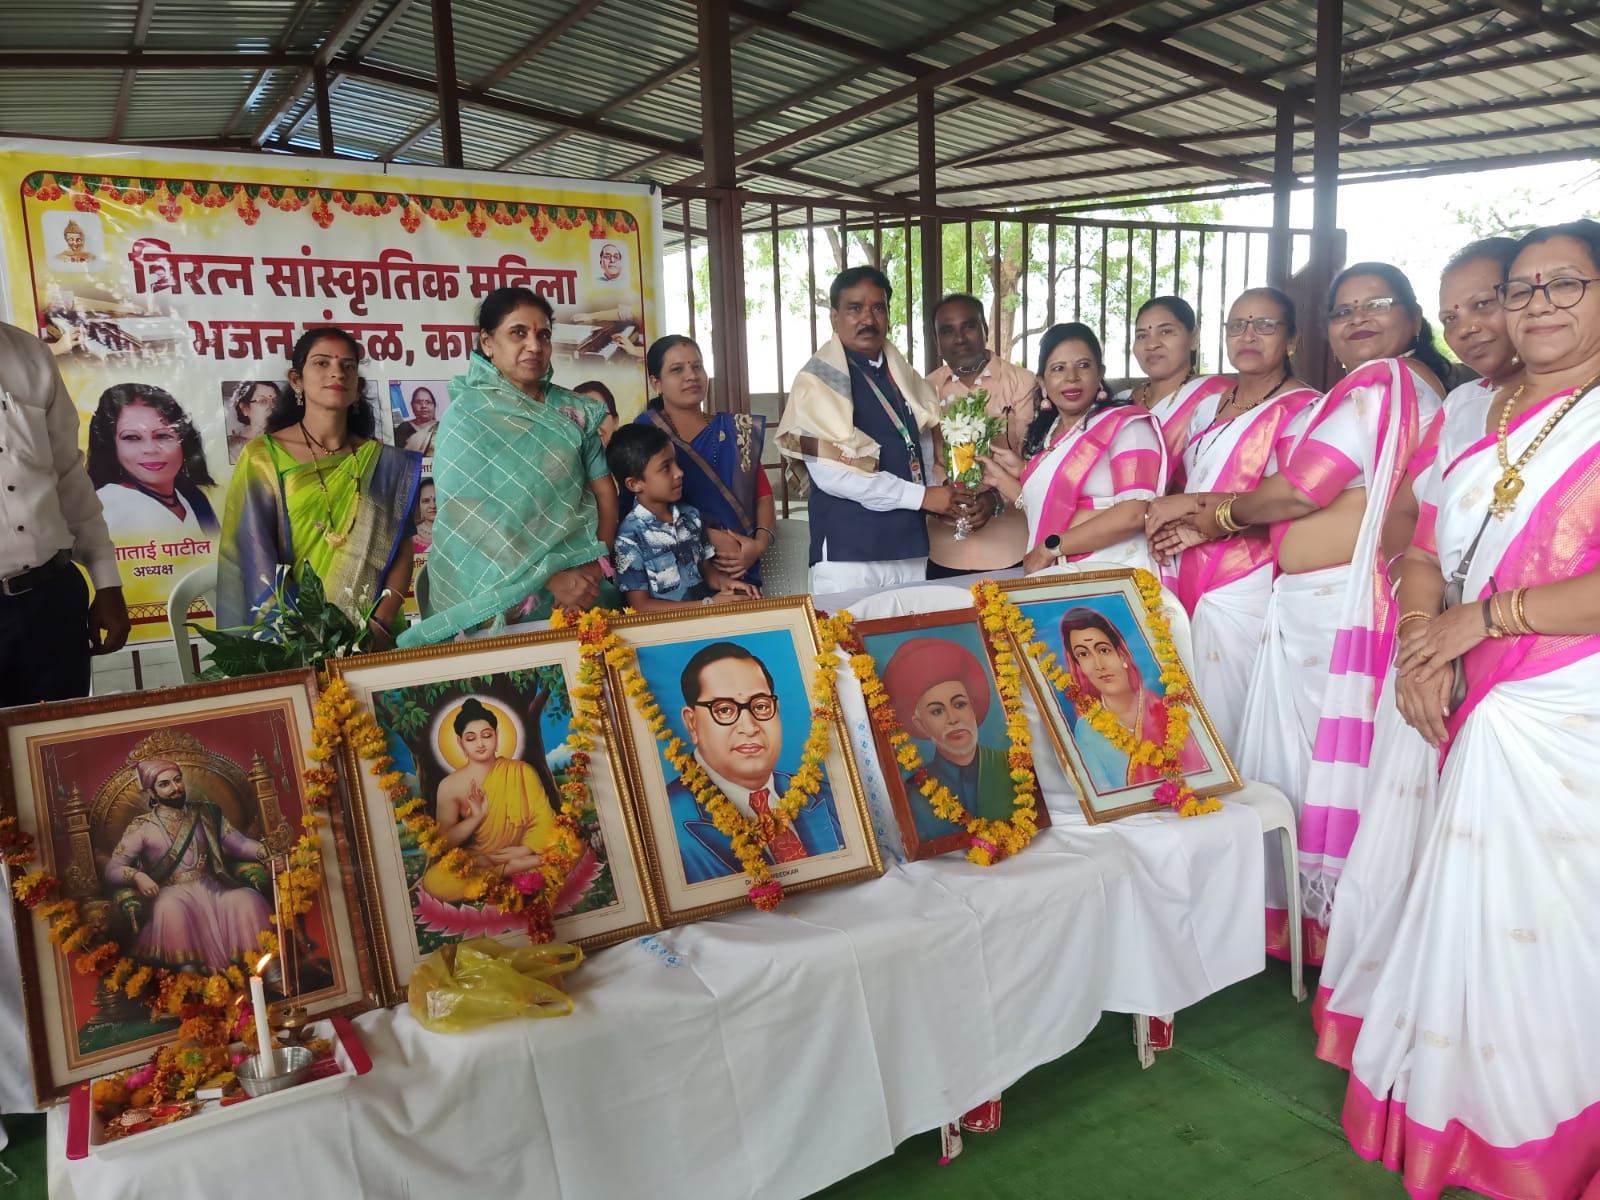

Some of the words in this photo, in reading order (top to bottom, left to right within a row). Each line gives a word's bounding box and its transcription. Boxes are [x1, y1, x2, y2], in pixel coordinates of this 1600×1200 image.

[261, 244, 460, 316] सांस्कृतिक
[187, 320, 295, 360] भजन
[161, 538, 212, 557] पाटील
[133, 564, 174, 577] अध्यक्ष
